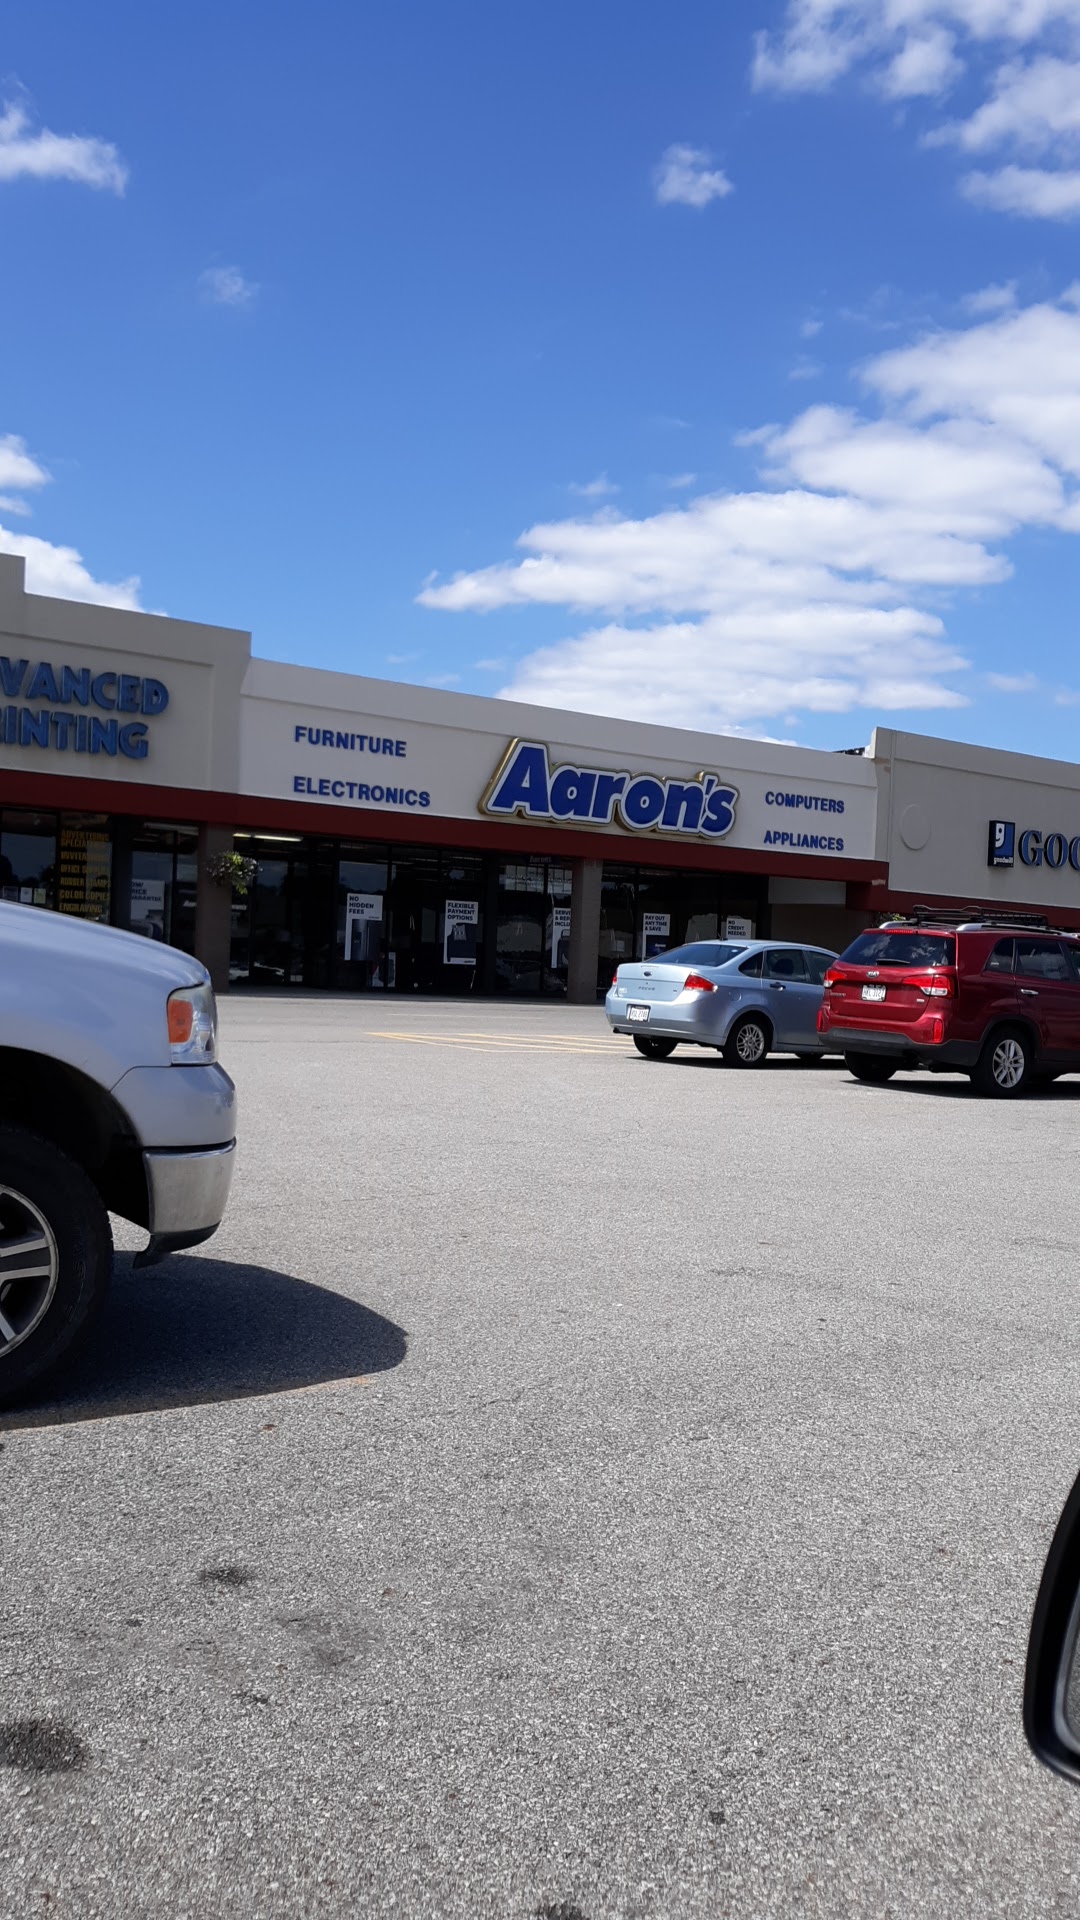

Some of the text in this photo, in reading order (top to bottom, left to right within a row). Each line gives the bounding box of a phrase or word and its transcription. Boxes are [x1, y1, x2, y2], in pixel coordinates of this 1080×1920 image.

[0, 656, 170, 716] VANCED
[0, 704, 149, 760] INTING
[294, 725, 408, 758] FURNITURE
[292, 775, 432, 808] ELECTRONICS
[489, 743, 737, 834] Aaron's
[764, 790, 846, 814] COMPUTERS
[763, 829, 845, 852] APPLIANCES
[993, 856, 1014, 866] goodwill
[58, 902, 103, 913] ENGRAVING
[59, 889, 84, 900] COLOR
